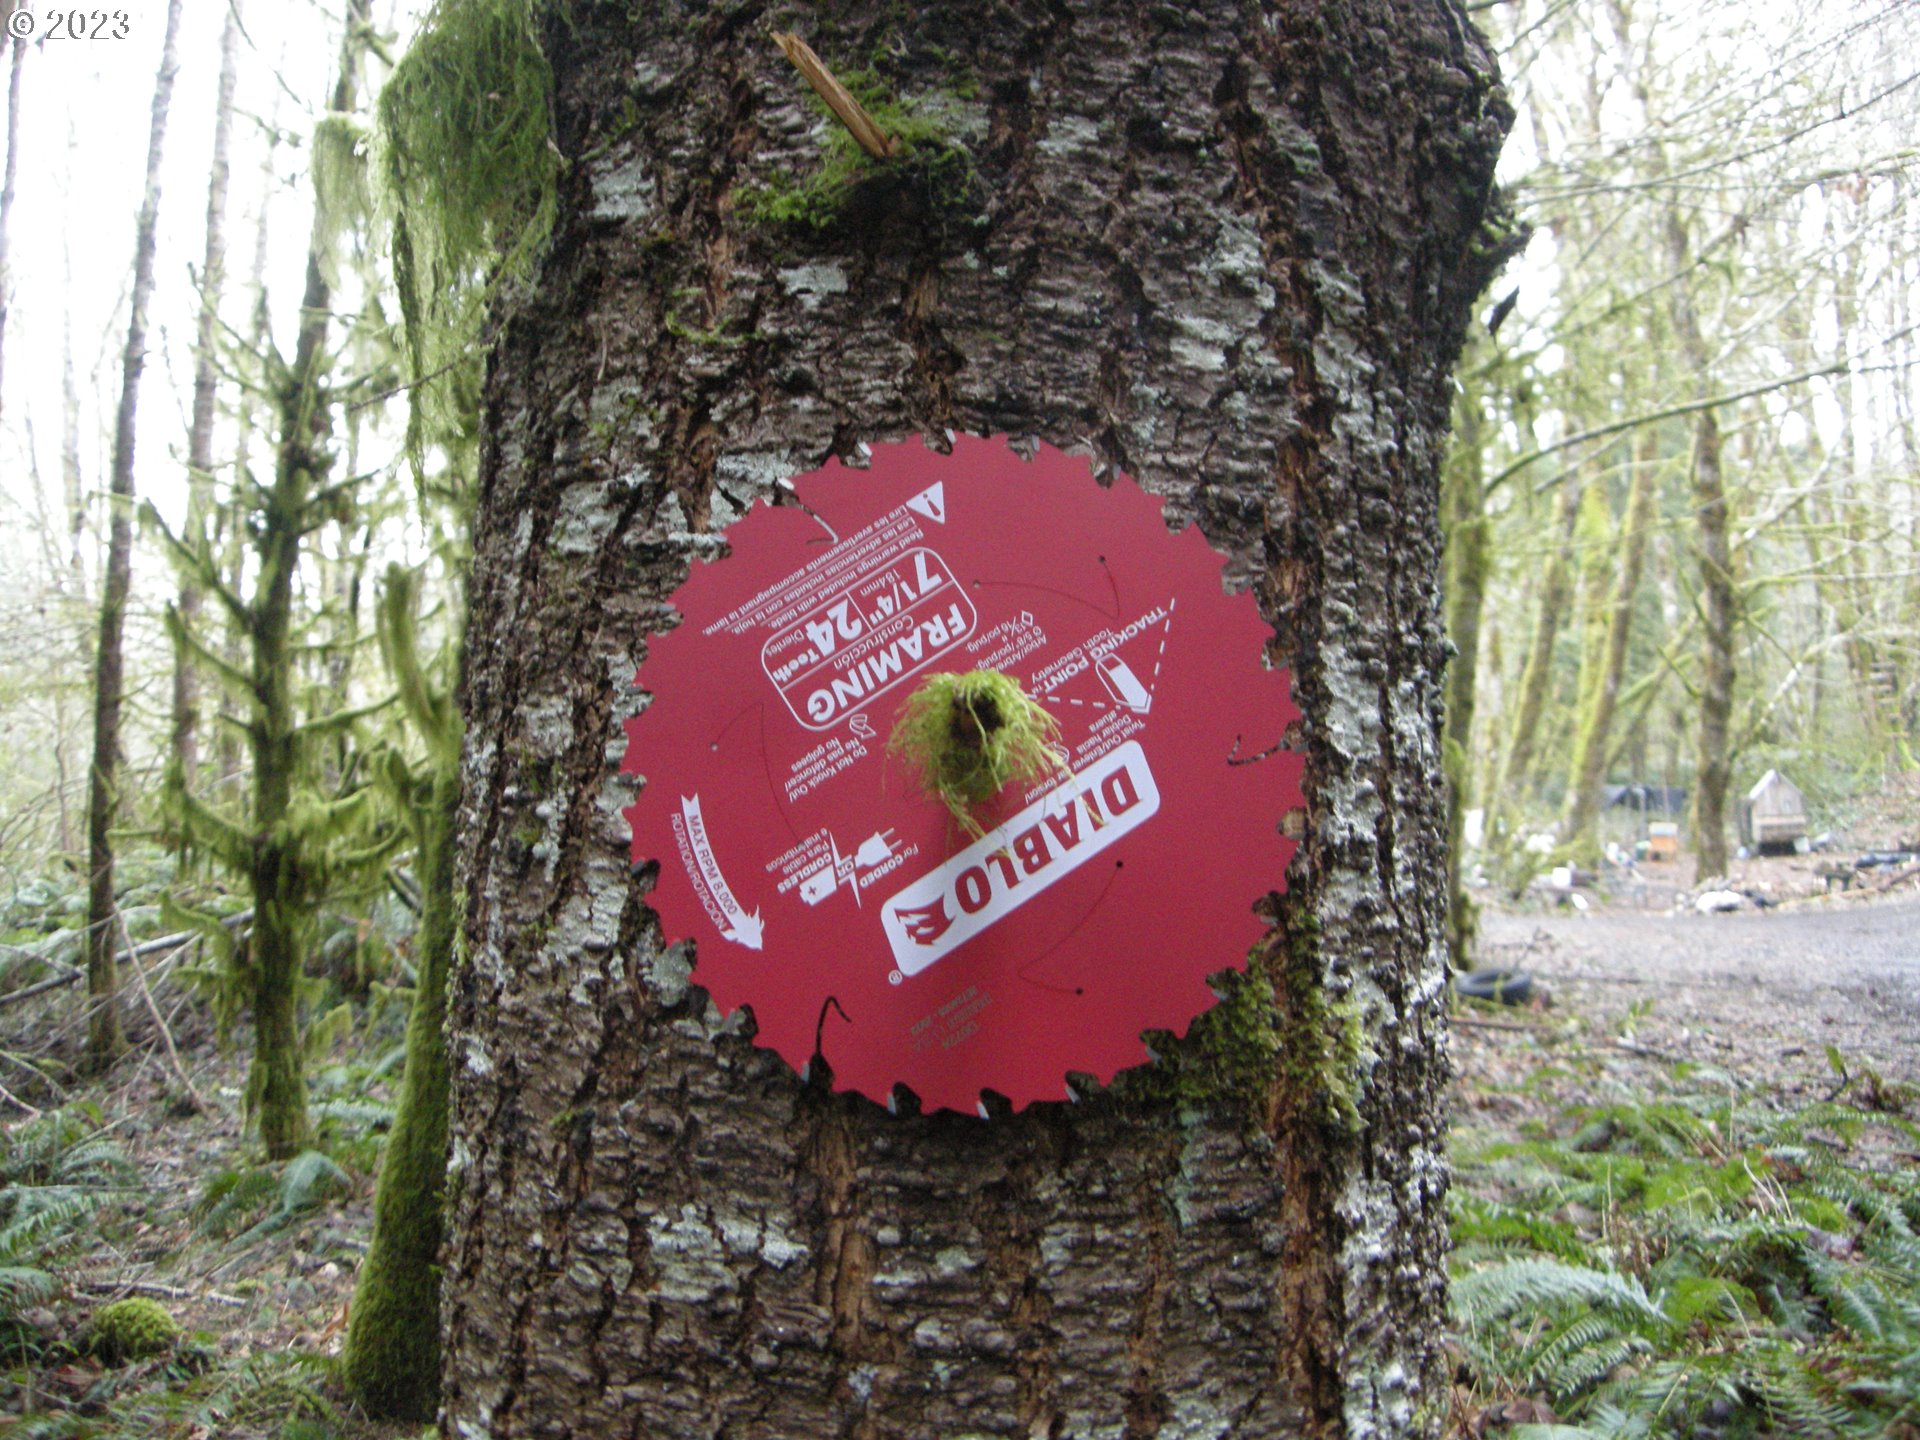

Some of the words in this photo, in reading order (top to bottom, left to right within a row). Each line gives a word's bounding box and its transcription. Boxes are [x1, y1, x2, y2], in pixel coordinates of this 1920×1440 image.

[873, 515, 889, 529] les
[888, 504, 908, 519] Lire
[881, 527, 897, 540] las
[896, 516, 915, 531] Lea
[805, 525, 873, 571] avertissements
[898, 528, 924, 549] Read
[824, 536, 881, 576] advertencias
[856, 544, 899, 573] warnings
[738, 567, 805, 615] accompagnant
[783, 573, 825, 601] incluidas
[817, 570, 857, 600] included
[859, 568, 900, 596] 184mm
[728, 610, 739, 620] la
[754, 610, 766, 620] la
[764, 599, 783, 614] con
[796, 595, 817, 612] with
[804, 598, 862, 656] 24
[1082, 627, 1114, 649] Tooth
[1089, 606, 1167, 661] TRACKING
[762, 628, 804, 656] Dientes
[833, 614, 913, 670] Construcción
[772, 648, 819, 682] Teeth
[807, 602, 966, 722] FRAMING
[1031, 646, 1082, 684] Geometry
[1088, 709, 1116, 732] afuera
[1101, 713, 1131, 737] Doblar
[1119, 719, 1145, 738] Twist
[825, 736, 841, 749] No
[826, 744, 844, 761] pas
[844, 736, 860, 750] Ne
[852, 744, 867, 757] Do
[1076, 733, 1102, 754] hacia
[835, 754, 853, 770] Not
[806, 764, 836, 787] Knock
[806, 840, 829, 858] Para
[954, 765, 1139, 914] DIABLO
[687, 815, 704, 846] MAX
[697, 849, 719, 880] RPM
[711, 881, 738, 916] 8,000
[777, 851, 832, 893] CORDLESS
[782, 854, 806, 874] cable
[835, 858, 857, 878] OR
[859, 853, 903, 888] CORDED
